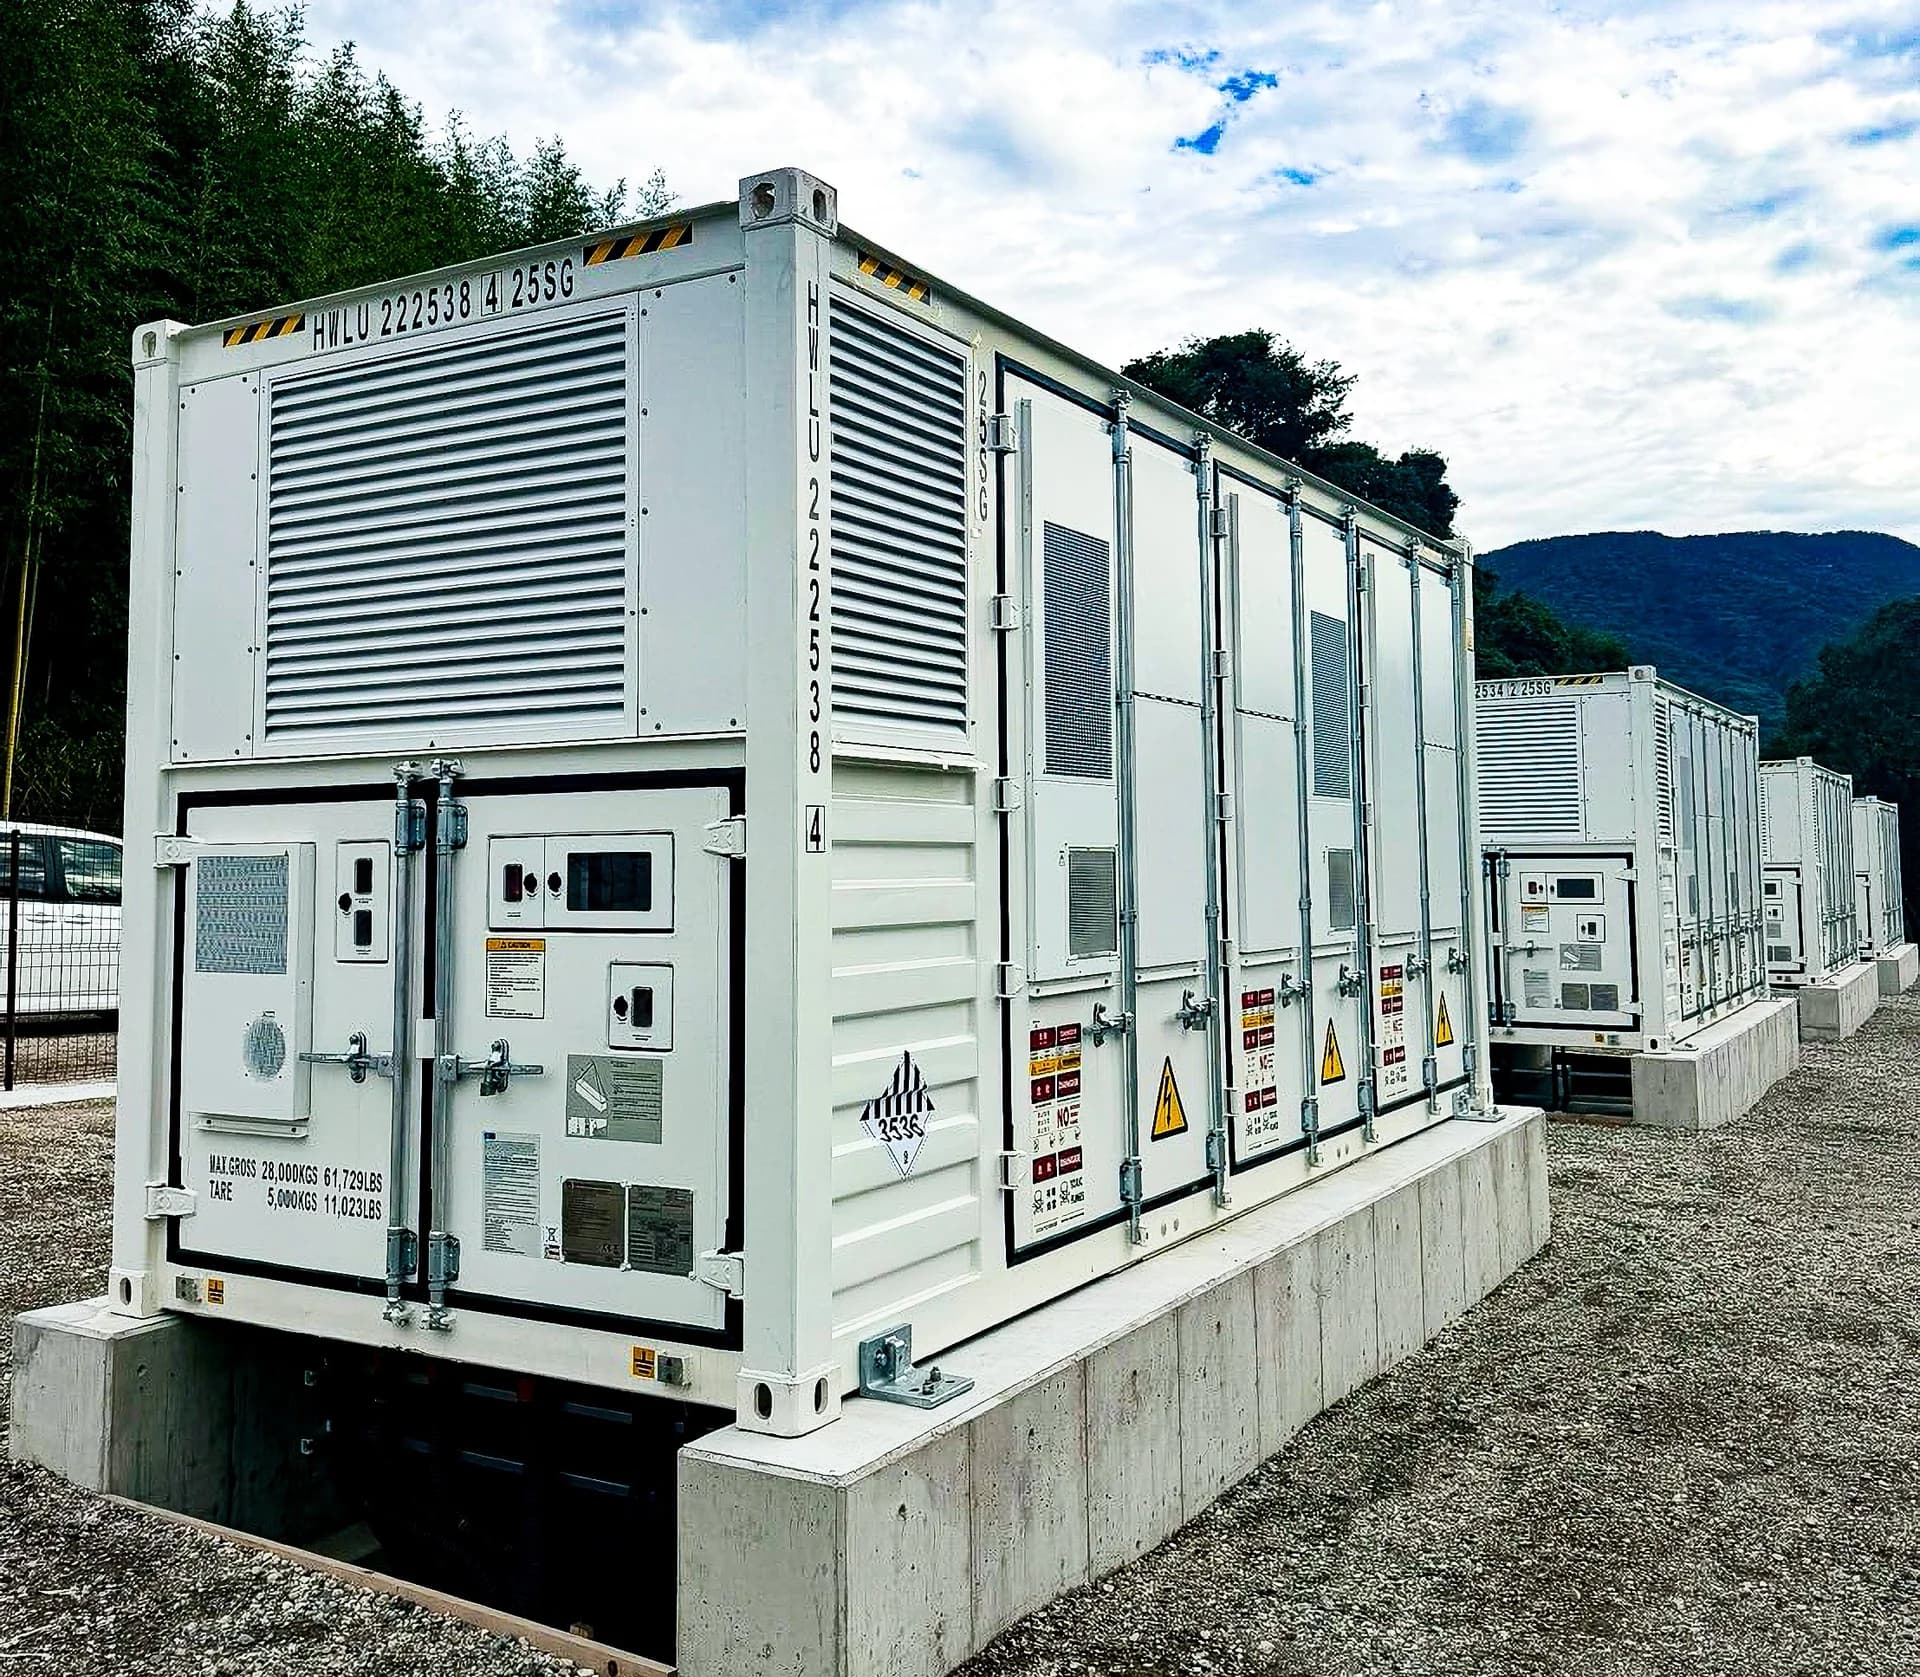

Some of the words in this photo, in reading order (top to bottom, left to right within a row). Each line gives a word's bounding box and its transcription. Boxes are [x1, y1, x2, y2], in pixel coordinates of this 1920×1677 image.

[313, 302, 369, 351] HWLU
[381, 280, 471, 337] 222538
[484, 272, 499, 314] 4
[511, 258, 574, 308] 25SG
[807, 280, 820, 463] HWLU
[979, 370, 988, 522] 25SG
[808, 477, 820, 774] 222538
[1521, 680, 1551, 696] 25SG
[808, 806, 823, 852] 4
[878, 1113, 925, 1143] 3536
[1057, 1106, 1070, 1128] NO
[262, 1160, 318, 1186] 28,000KGS
[324, 1167, 383, 1193] 61,729LBS
[209, 1179, 233, 1201] TARE
[267, 1186, 317, 1212] 5,000KGS
[324, 1194, 382, 1221] 11,023LBS
